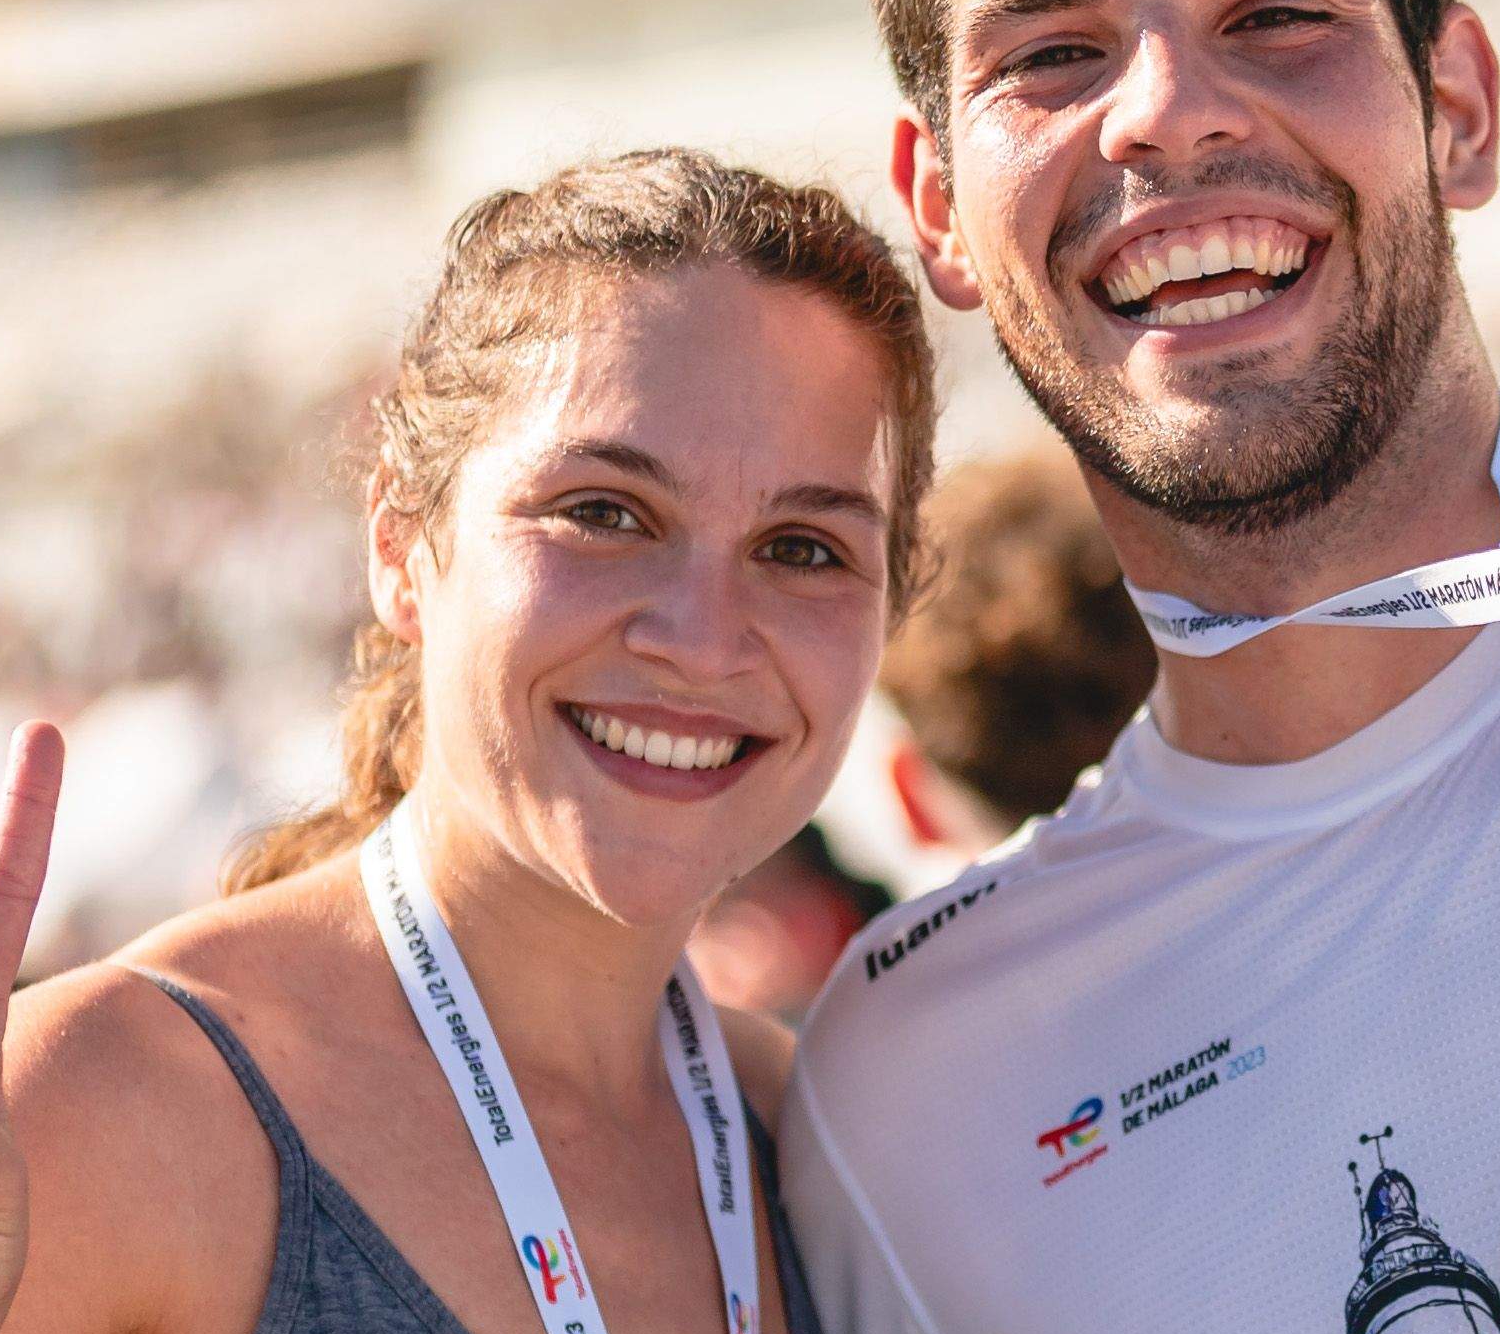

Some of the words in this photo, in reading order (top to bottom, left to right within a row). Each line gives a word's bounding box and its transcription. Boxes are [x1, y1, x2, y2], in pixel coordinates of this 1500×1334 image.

[1427, 574, 1486, 607] MARATÓN
[446, 1012, 515, 1148] TotalEnergies
[1122, 1109, 1144, 1135] DE
[1147, 1070, 1219, 1120] MÁLAGA
[1226, 1045, 1266, 1081] 2023
[1148, 1037, 1231, 1092] MARATÓN
